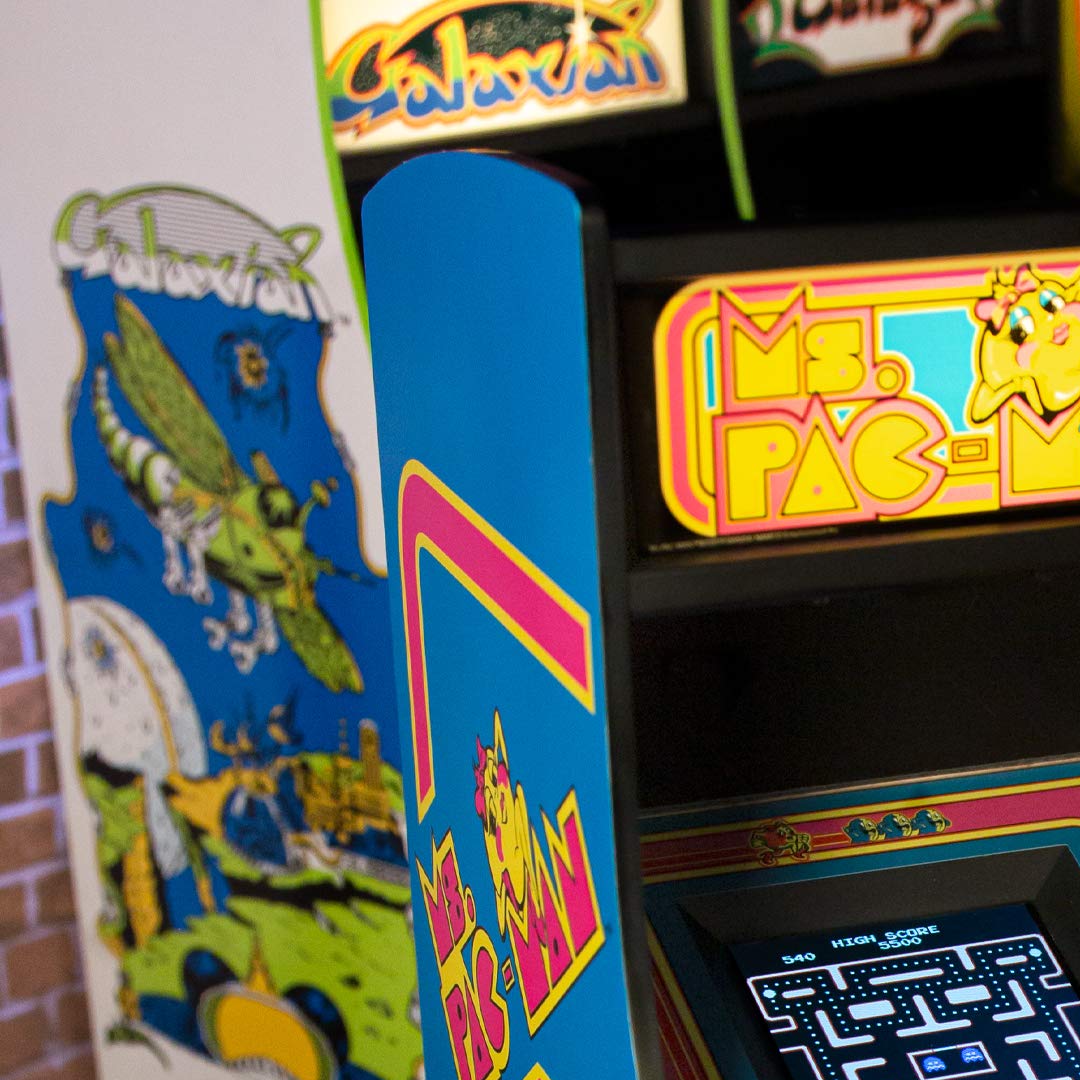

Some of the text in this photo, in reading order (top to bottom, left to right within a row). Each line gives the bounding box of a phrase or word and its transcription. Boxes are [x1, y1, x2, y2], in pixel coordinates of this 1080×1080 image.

[831, 925, 940, 948] HIGH SCORE
[878, 937, 922, 950] 5500
[781, 952, 816, 964] 540
